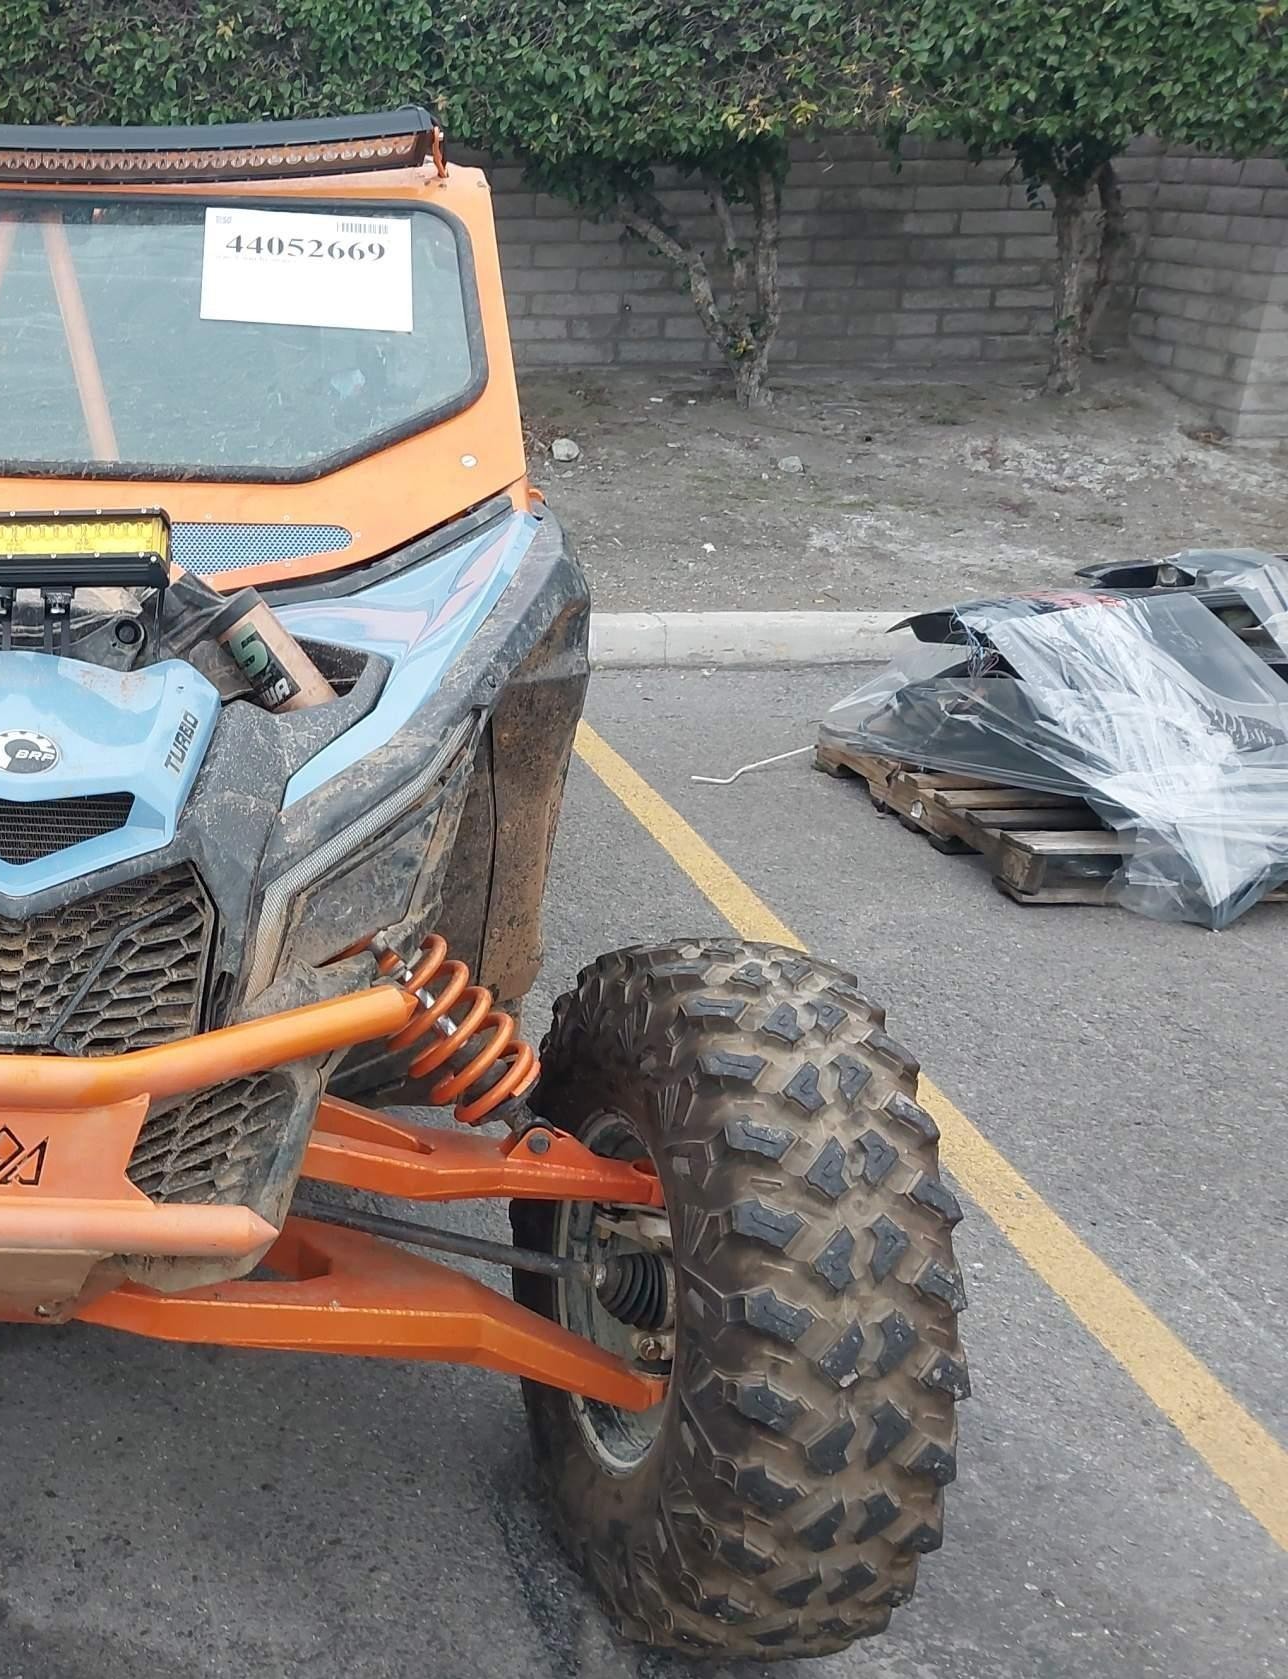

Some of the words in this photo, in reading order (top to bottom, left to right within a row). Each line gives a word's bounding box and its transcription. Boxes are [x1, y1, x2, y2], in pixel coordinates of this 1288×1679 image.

[225, 234, 386, 261] 44052669
[15, 749, 56, 762] BRP
[164, 710, 199, 774] TURBO
